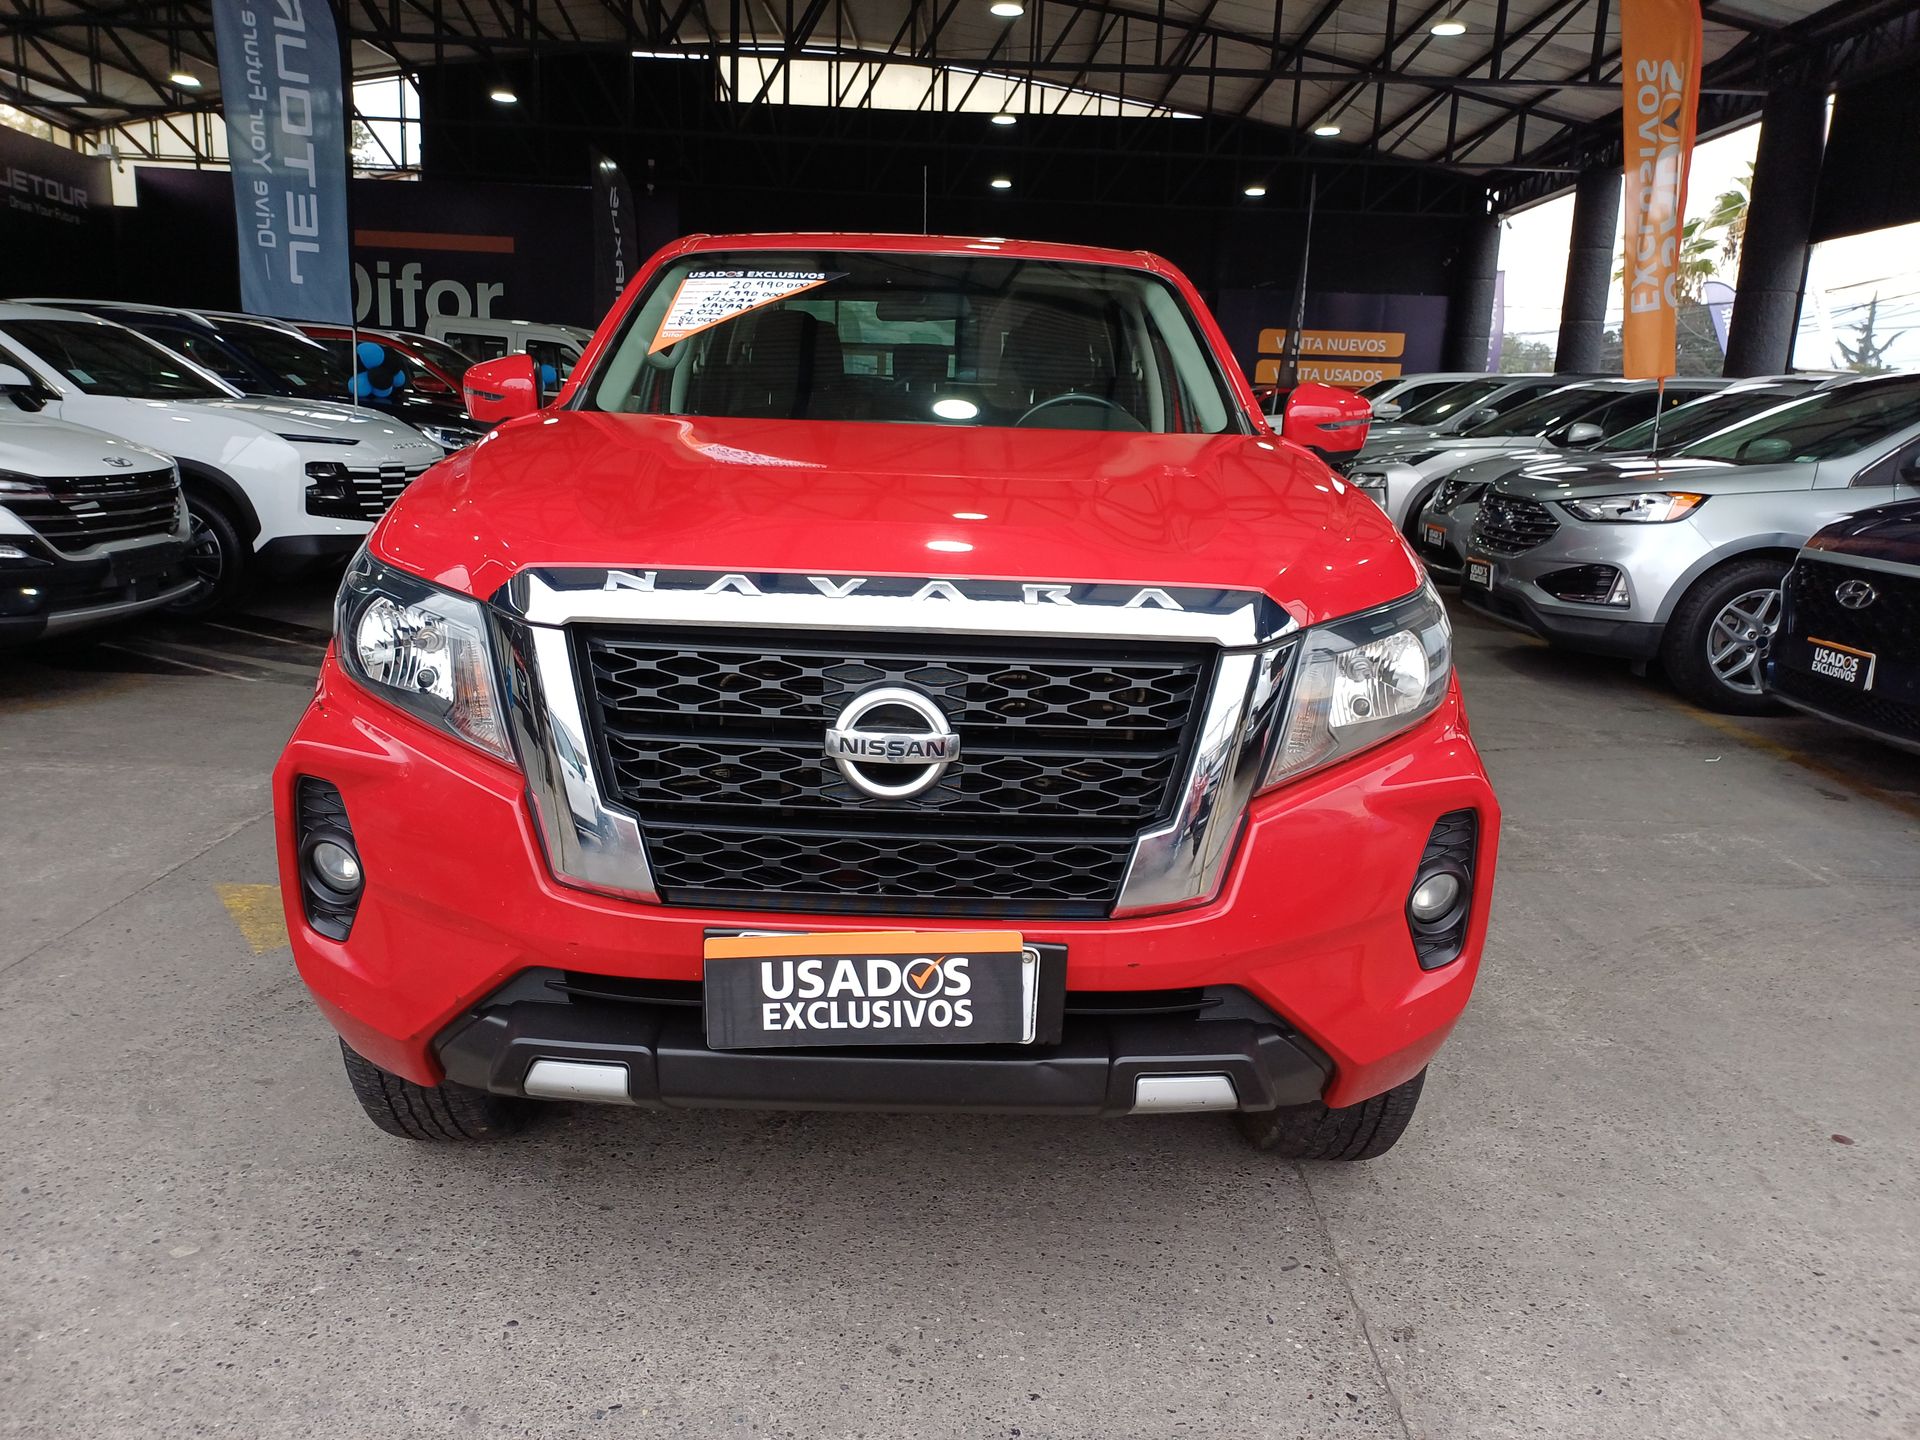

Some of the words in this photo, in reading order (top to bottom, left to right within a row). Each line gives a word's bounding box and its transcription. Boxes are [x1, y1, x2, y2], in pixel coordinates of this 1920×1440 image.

[0, 167, 88, 209] JETOUR
[688, 271, 744, 279] USADOS
[747, 271, 826, 280] EXCLUSIVOS
[700, 303, 754, 311] NAVARA
[1276, 336, 1323, 351] VNTA
[1327, 339, 1387, 352] NUEVOS
[1273, 367, 1319, 380] VNTA
[1324, 369, 1383, 383] USADOS
[602, 570, 1185, 611] NAVARA
[1814, 647, 1859, 672] USADOS
[1811, 660, 1857, 683] EXCLUSIVOS
[840, 737, 946, 757] NISSAN
[760, 957, 972, 1000] USADOS
[762, 999, 973, 1031] EXCLUSIVOS
